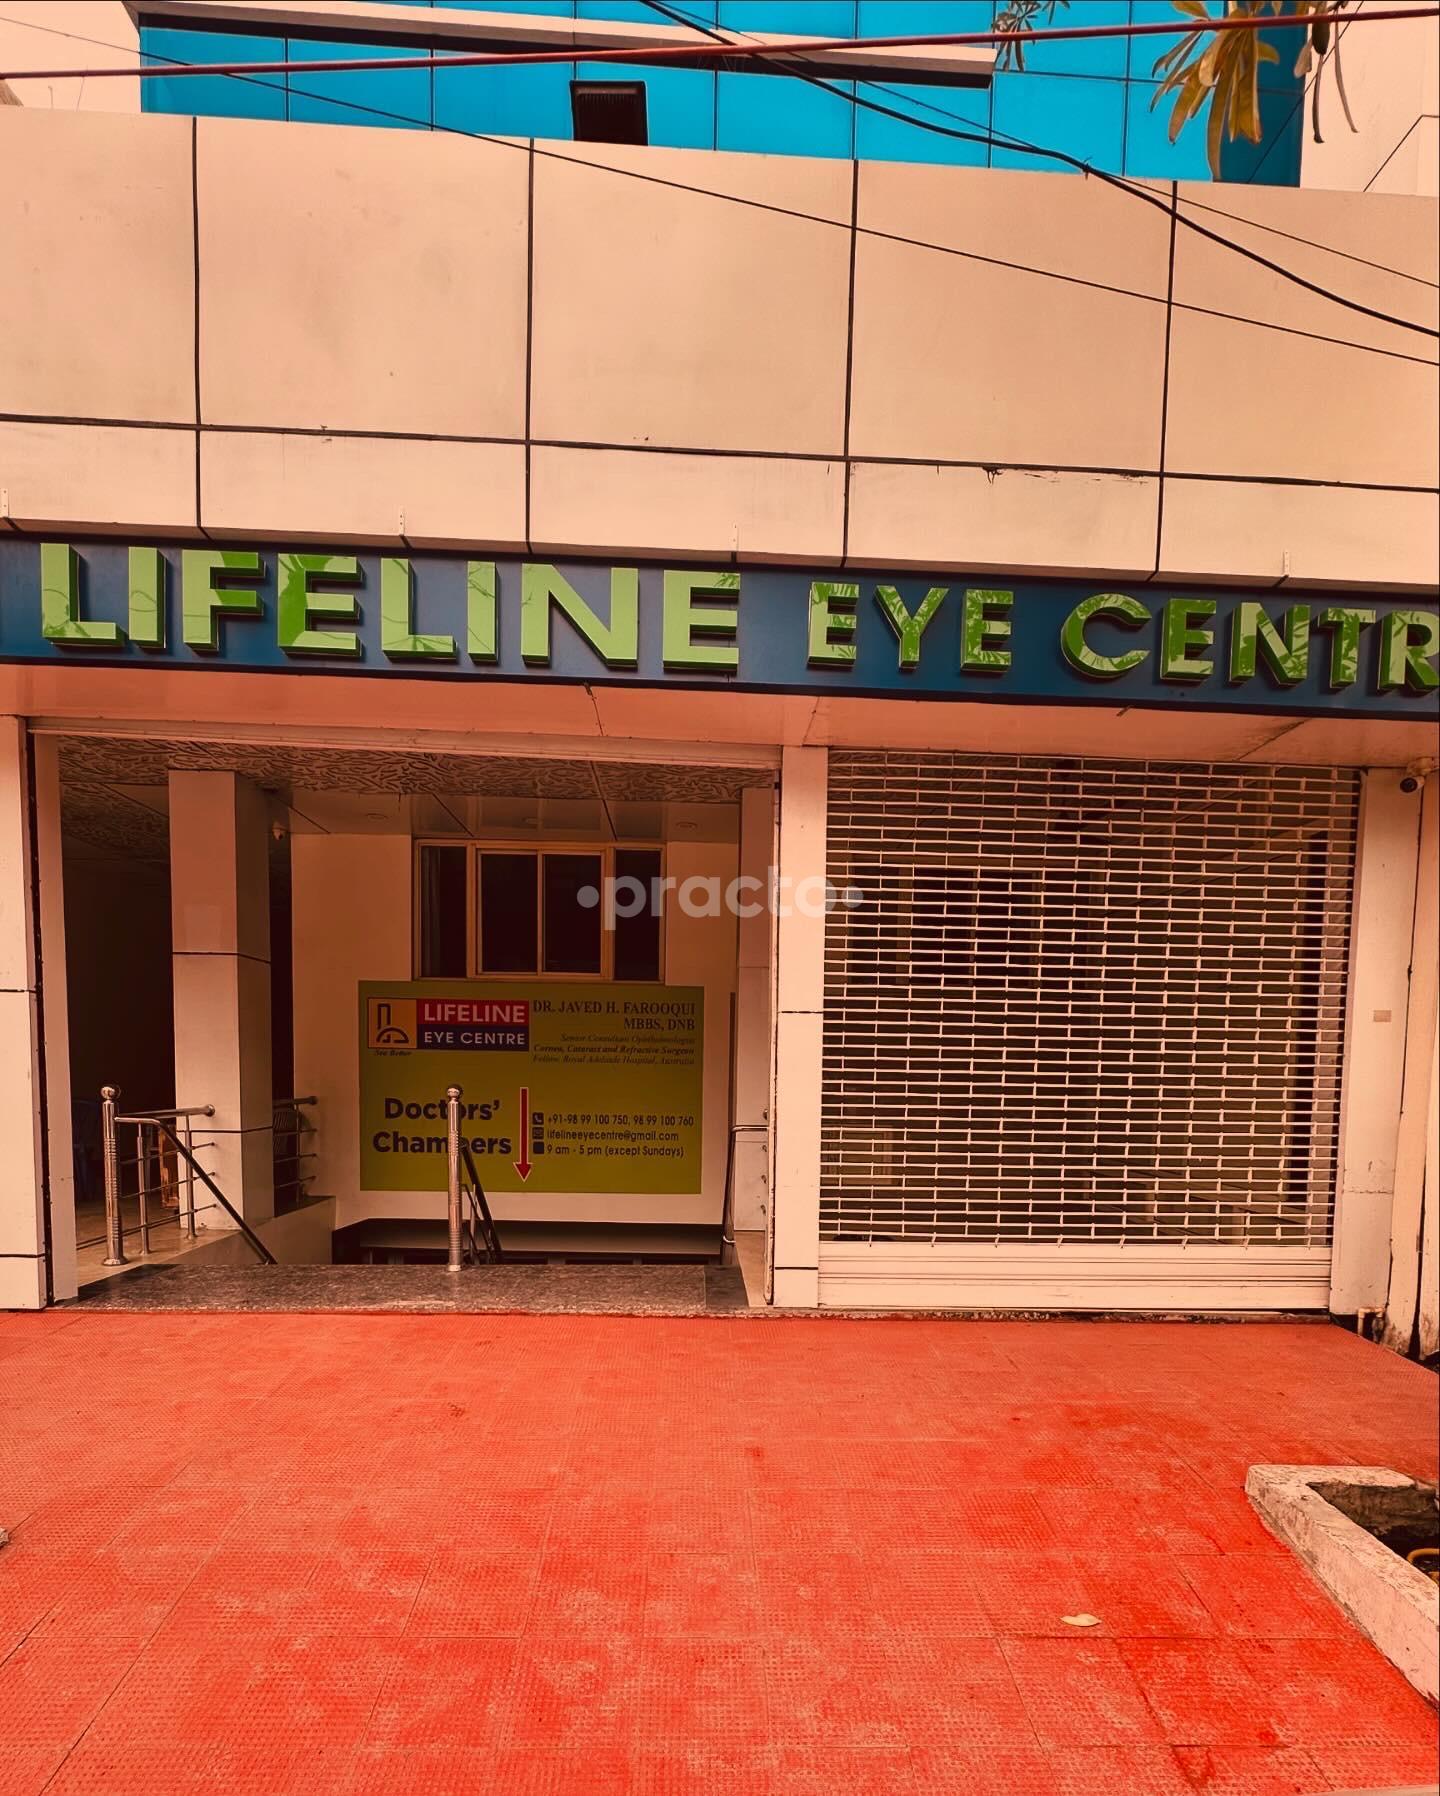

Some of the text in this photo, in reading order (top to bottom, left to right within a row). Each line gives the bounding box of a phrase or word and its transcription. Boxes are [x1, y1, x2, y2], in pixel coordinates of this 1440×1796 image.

[41, 543, 1440, 692] LIFELINE EYE CENTR
[424, 1003, 525, 1023] LIFELINE
[533, 1000, 695, 1017] DR. JAVED H. FAROOQUI
[623, 1018, 695, 1031] MBBS, DNB
[424, 1031, 525, 1045] EYE CENTRE
[580, 1114, 592, 1125] 99
[594, 1114, 610, 1125] 100
[647, 1115, 657, 1126] 99
[660, 1115, 675, 1127] 100
[678, 1116, 694, 1127] 760
[372, 1131, 512, 1154] Chamers
[547, 1129, 679, 1143] lifelineeyecentre@gmail.com
[547, 1144, 553, 1154] 9
[555, 1146, 570, 1155] am
[579, 1145, 585, 1155] 5
[587, 1146, 602, 1158] pm
[605, 1146, 641, 1158] (except
[643, 1146, 684, 1159] Sundays)
